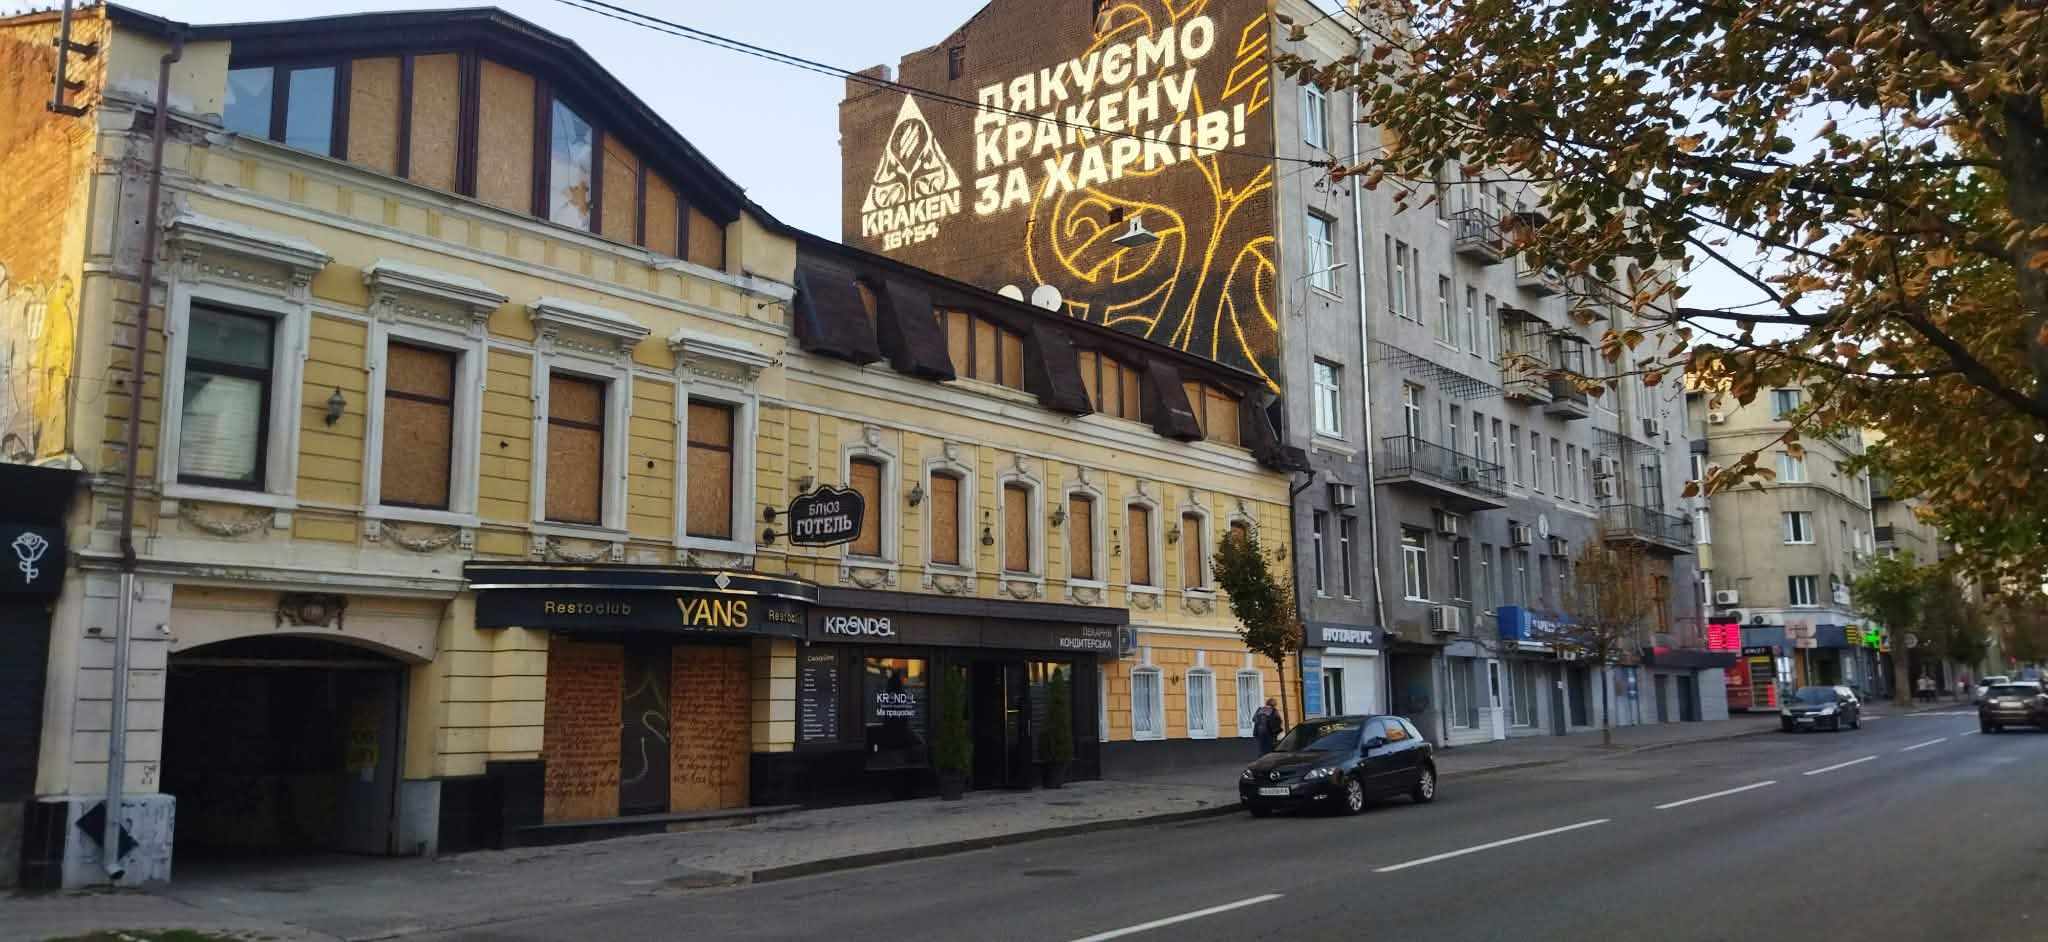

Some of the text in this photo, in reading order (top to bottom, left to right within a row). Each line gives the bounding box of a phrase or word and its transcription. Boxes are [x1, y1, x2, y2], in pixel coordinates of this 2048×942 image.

[975, 16, 1215, 134] ДЯКУЄМО
[976, 68, 1196, 171] КРАКЕНУ
[974, 104, 1246, 215] ЗА ХАРКІВ!
[862, 190, 960, 237] KRAKEN
[796, 515, 852, 536] ГОТЕЛЬ
[808, 501, 840, 516] БЛЮЗ
[545, 601, 631, 616] Restoclub
[677, 598, 748, 628] YANS
